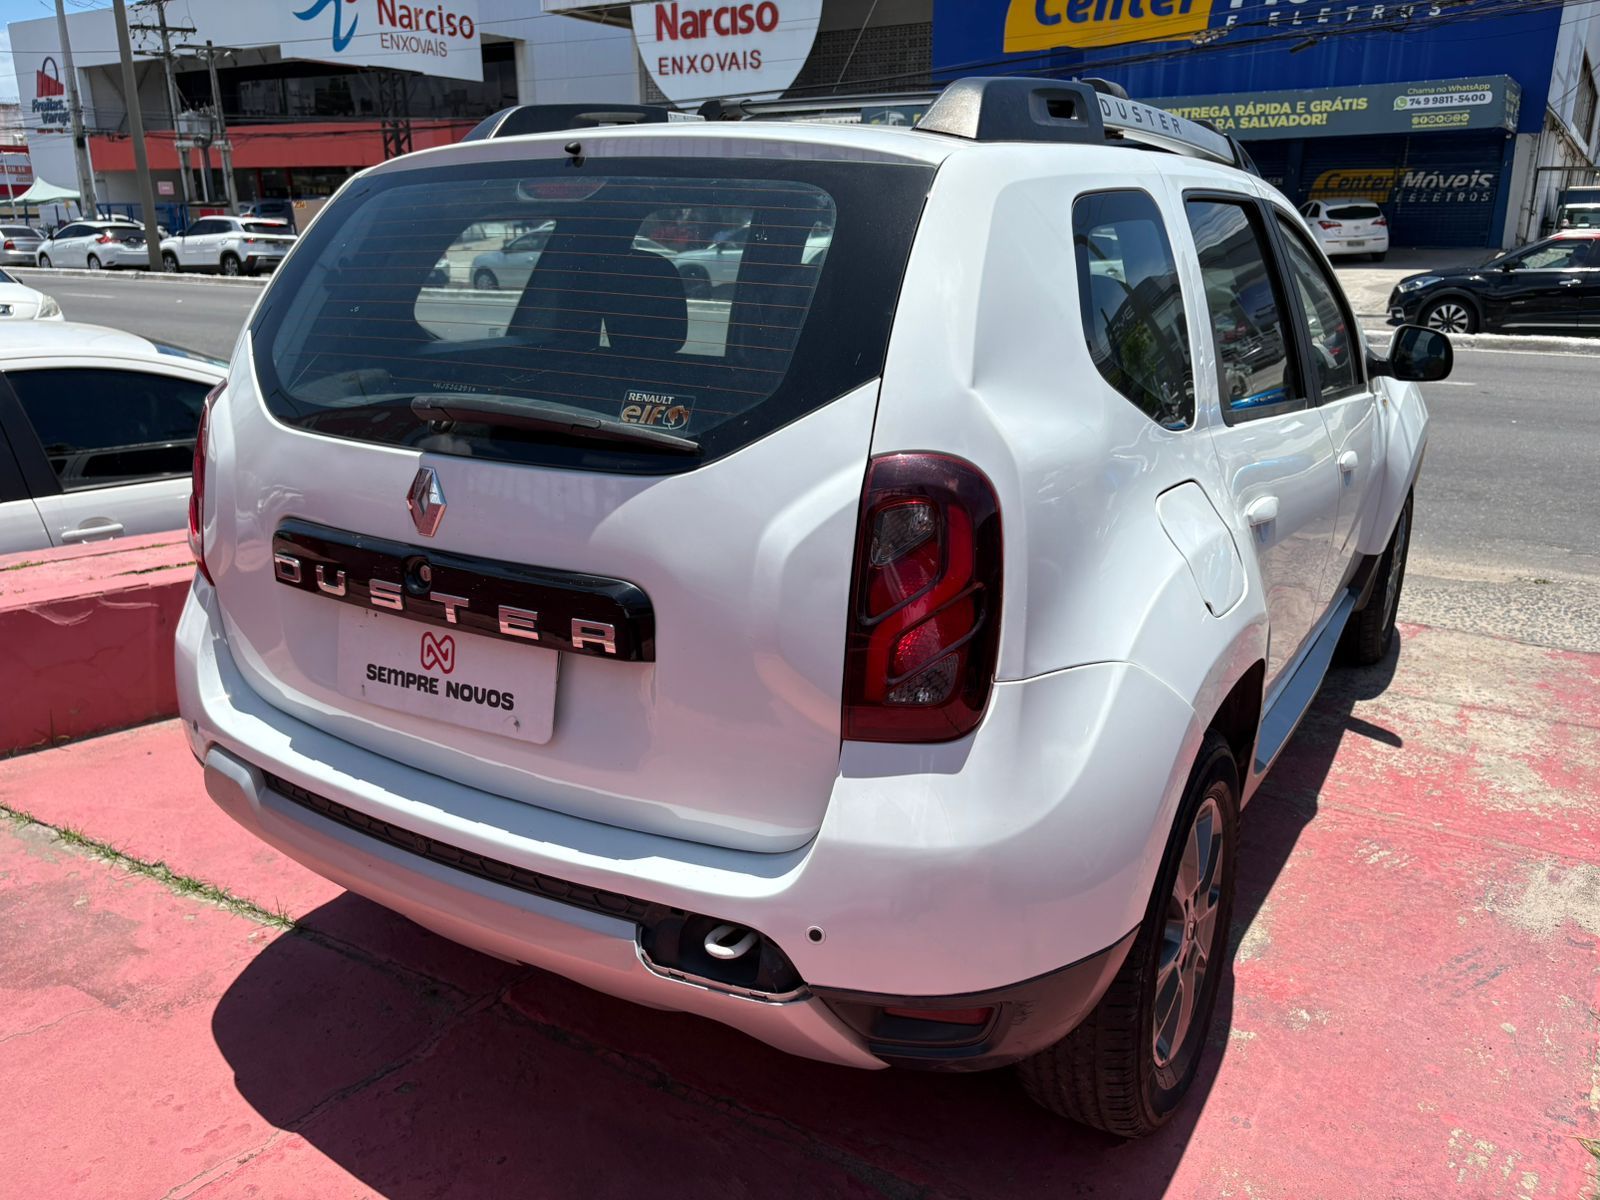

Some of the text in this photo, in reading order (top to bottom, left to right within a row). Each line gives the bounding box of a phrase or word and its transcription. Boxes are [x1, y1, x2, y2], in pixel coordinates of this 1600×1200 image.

[377, 0, 475, 39] Narciso
[655, 1, 779, 42] Narciso
[381, 33, 448, 57] ENXOVAIS
[658, 50, 762, 76] ENXOVAIS
[1407, 86, 1435, 95] Chama
[1448, 83, 1491, 93] WhatsApp
[1409, 93, 1486, 106] 74 9 9811-5400
[1099, 98, 1182, 134] DUSTER
[1235, 101, 1292, 116] RÁPIDA
[1297, 101, 1306, 113] E
[1311, 96, 1368, 112] GRÁTIS
[1240, 113, 1328, 129] SALVADOR!
[1402, 169, 1494, 188] Móveis
[628, 392, 675, 405] RENAULT
[621, 405, 666, 425] elf
[274, 552, 617, 655] DUSTER
[366, 663, 439, 695] SEMPRE
